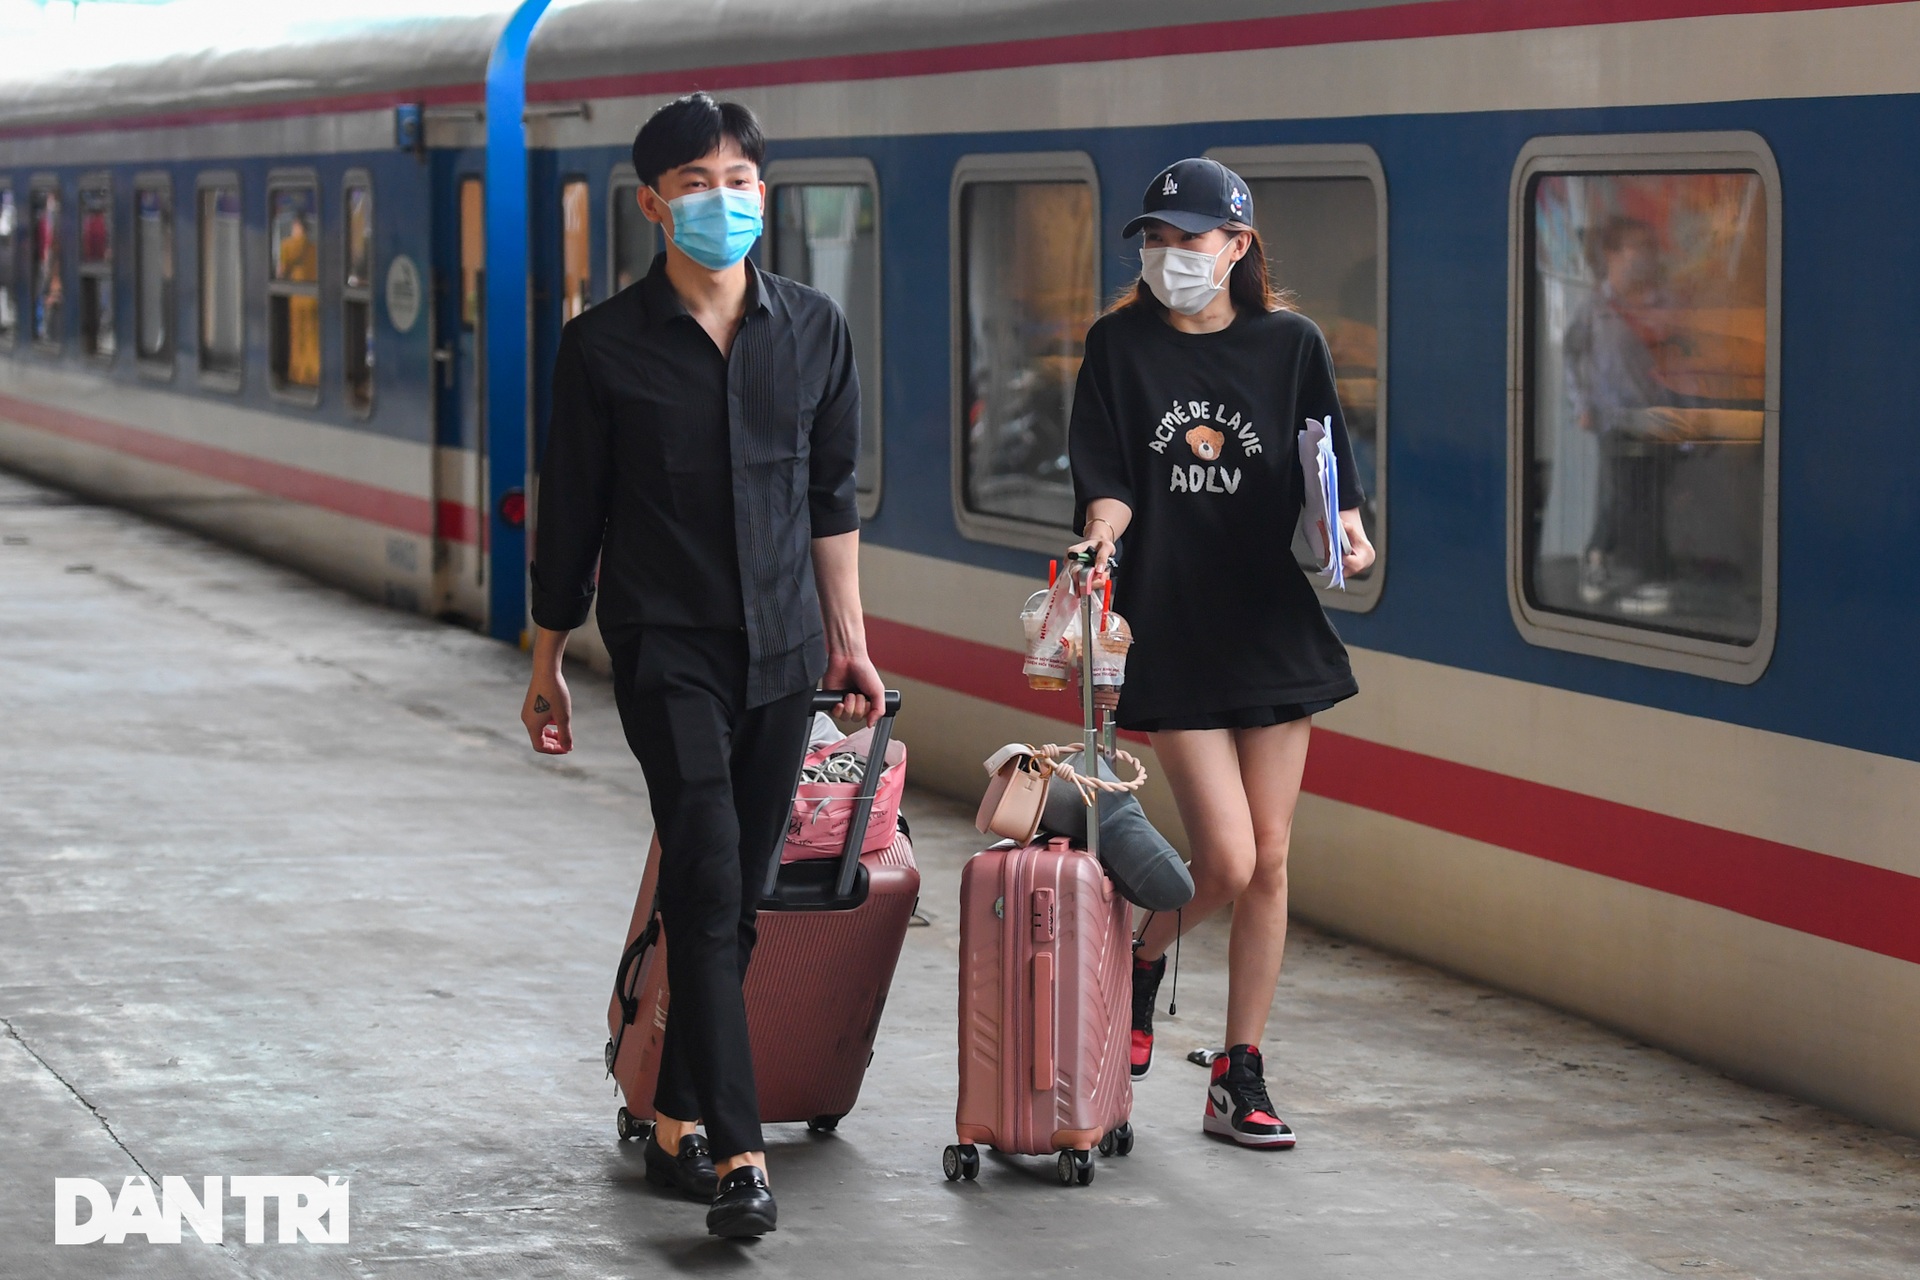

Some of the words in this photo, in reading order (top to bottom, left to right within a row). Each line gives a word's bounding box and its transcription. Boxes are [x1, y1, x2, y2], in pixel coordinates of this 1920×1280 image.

[1162, 173, 1178, 196] LA
[1188, 400, 1211, 420] DE
[1215, 404, 1242, 431] LA
[1237, 421, 1263, 458] VIE
[1169, 463, 1242, 495] ADLV
